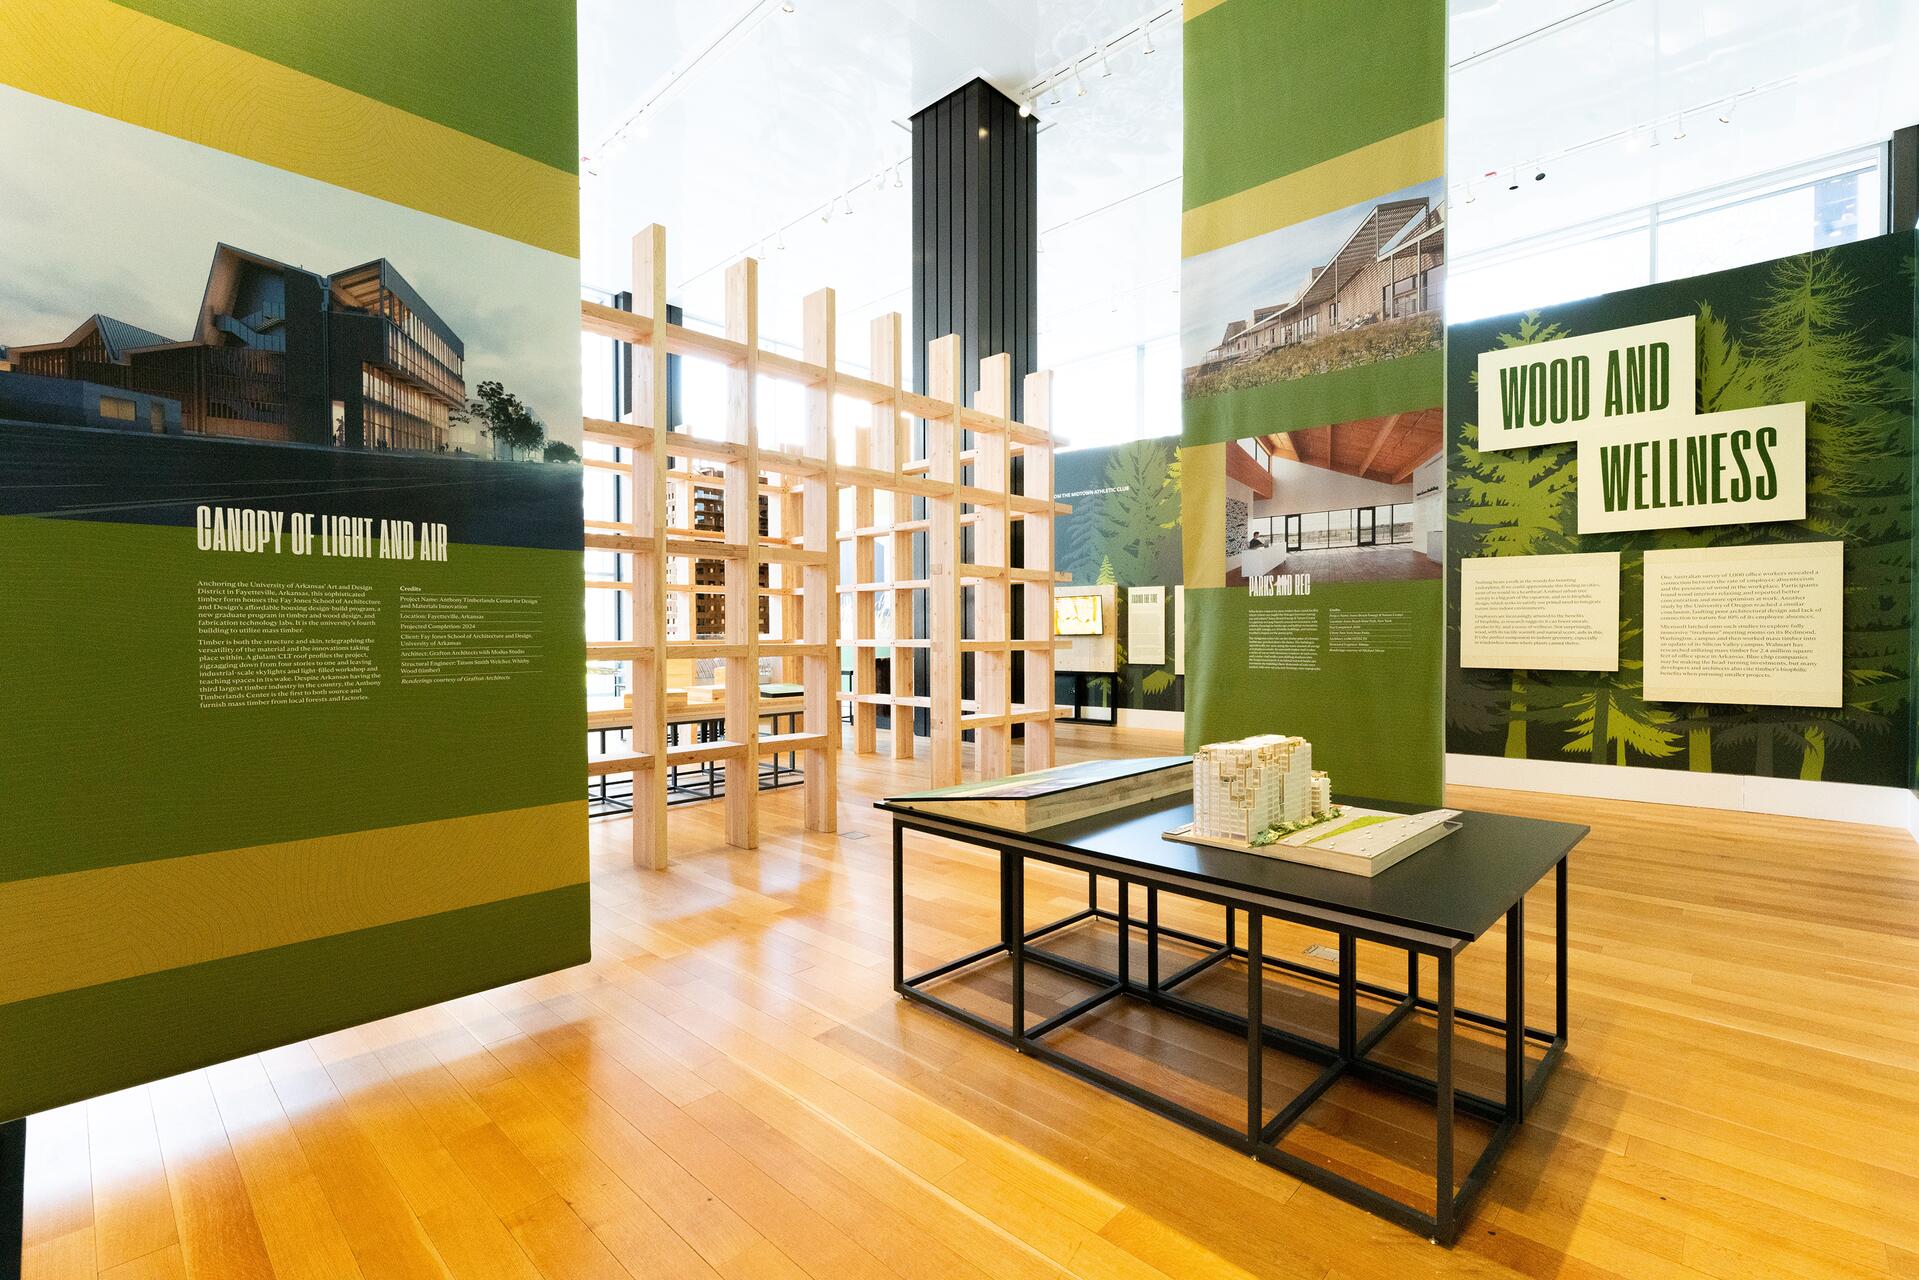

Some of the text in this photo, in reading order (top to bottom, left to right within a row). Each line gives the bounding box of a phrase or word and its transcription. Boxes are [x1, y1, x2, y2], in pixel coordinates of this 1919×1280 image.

[1500, 342, 1669, 430] WOOD AND
[1600, 427, 1777, 512] WELLNESS
[196, 505, 448, 561] CANOPY OF LIGHT AND AIR
[1249, 574, 1310, 596] PARKS AND REC
